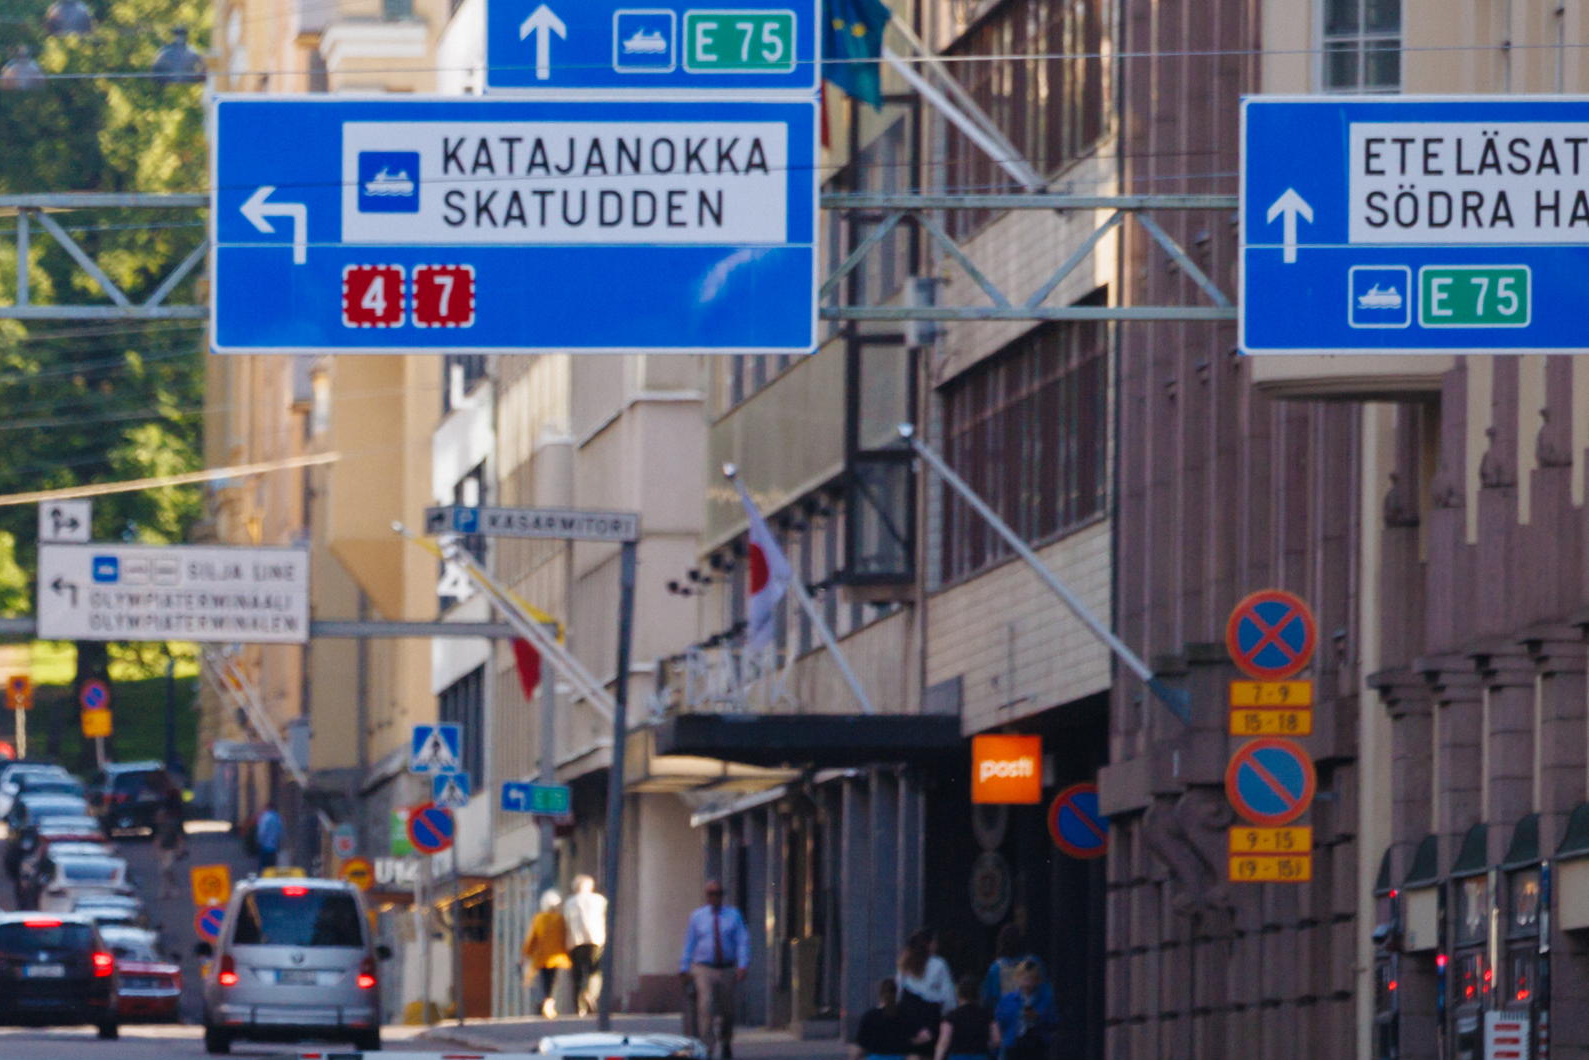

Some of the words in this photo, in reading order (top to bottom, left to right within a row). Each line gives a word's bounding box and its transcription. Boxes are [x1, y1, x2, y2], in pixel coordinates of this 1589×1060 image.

[695, 24, 719, 62] E
[738, 22, 785, 62] 75
[441, 137, 771, 175] KATAJANOKKA
[1363, 129, 1589, 176] ETELÄSAT
[442, 190, 724, 229] SKATUDDEN
[1365, 184, 1515, 229] SÖDRA
[1534, 190, 1589, 229] HA
[360, 277, 388, 317] 4
[433, 277, 456, 317] 7
[1431, 277, 1454, 316] E
[1470, 277, 1520, 316] 75
[488, 513, 632, 534] KASARMITORI
